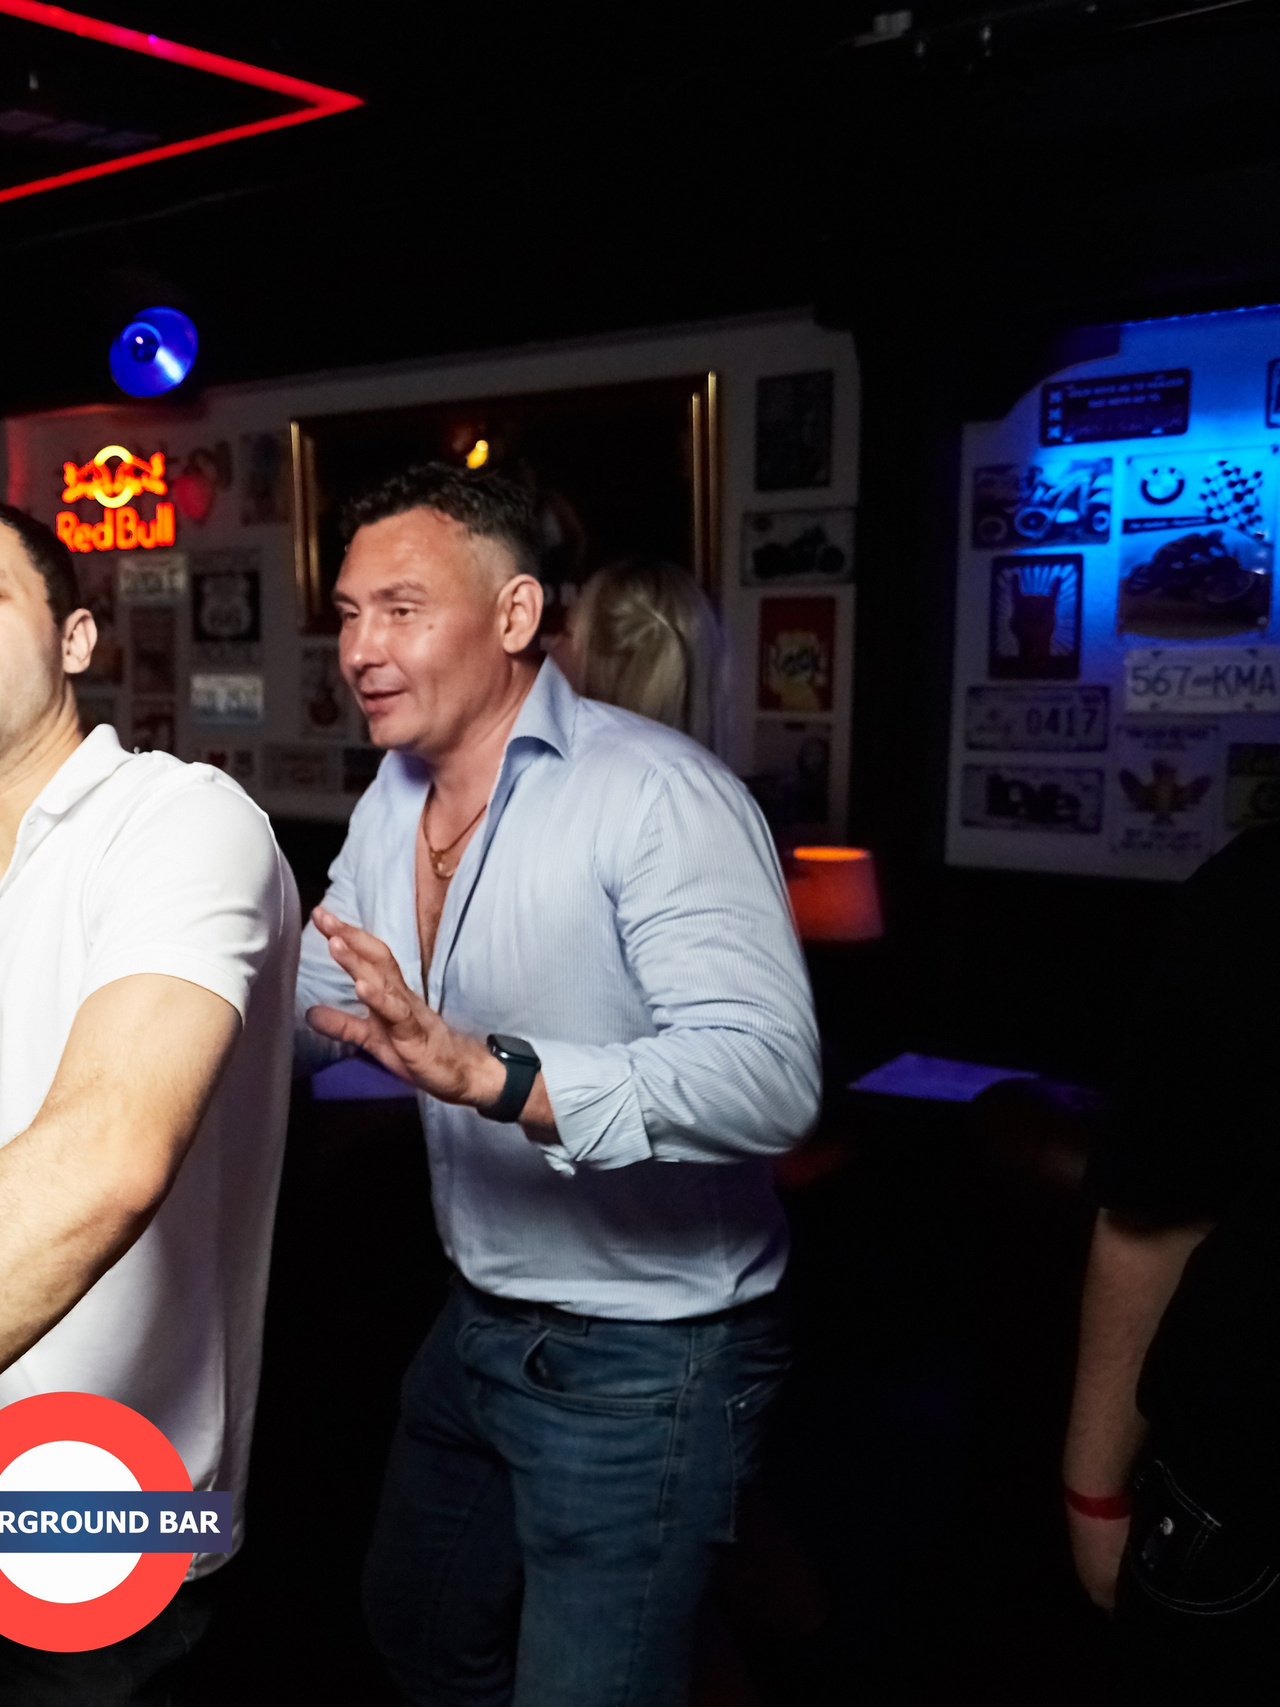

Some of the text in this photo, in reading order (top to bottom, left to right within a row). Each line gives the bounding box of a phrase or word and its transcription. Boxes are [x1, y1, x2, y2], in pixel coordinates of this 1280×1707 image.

[56, 502, 175, 553] Red Bull
[1025, 707, 1098, 737] 0417
